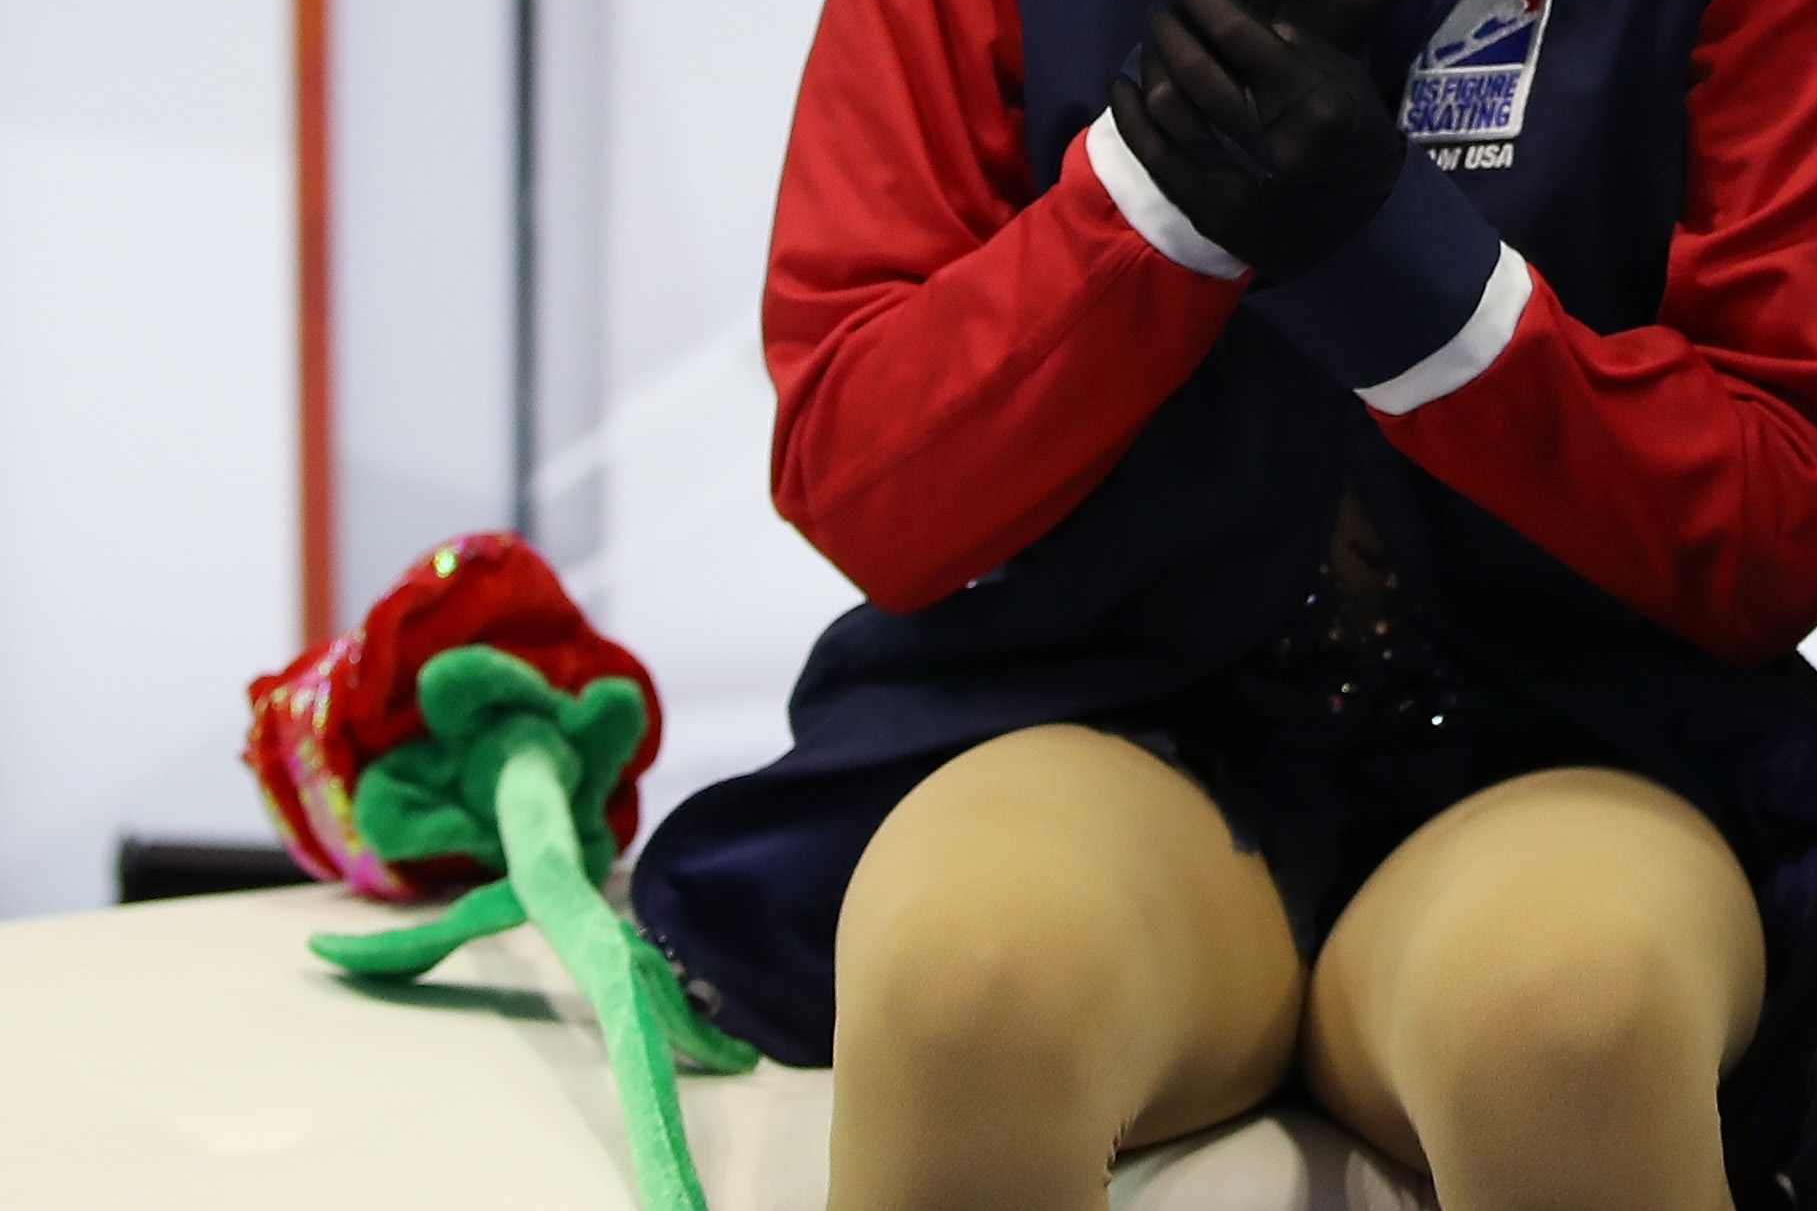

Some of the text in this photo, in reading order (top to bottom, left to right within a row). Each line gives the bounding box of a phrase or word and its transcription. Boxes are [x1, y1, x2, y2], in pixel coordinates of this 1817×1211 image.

[1443, 72, 1521, 106] FIGURE
[1406, 102, 1512, 133] SKATING
[1464, 143, 1515, 170] USA
